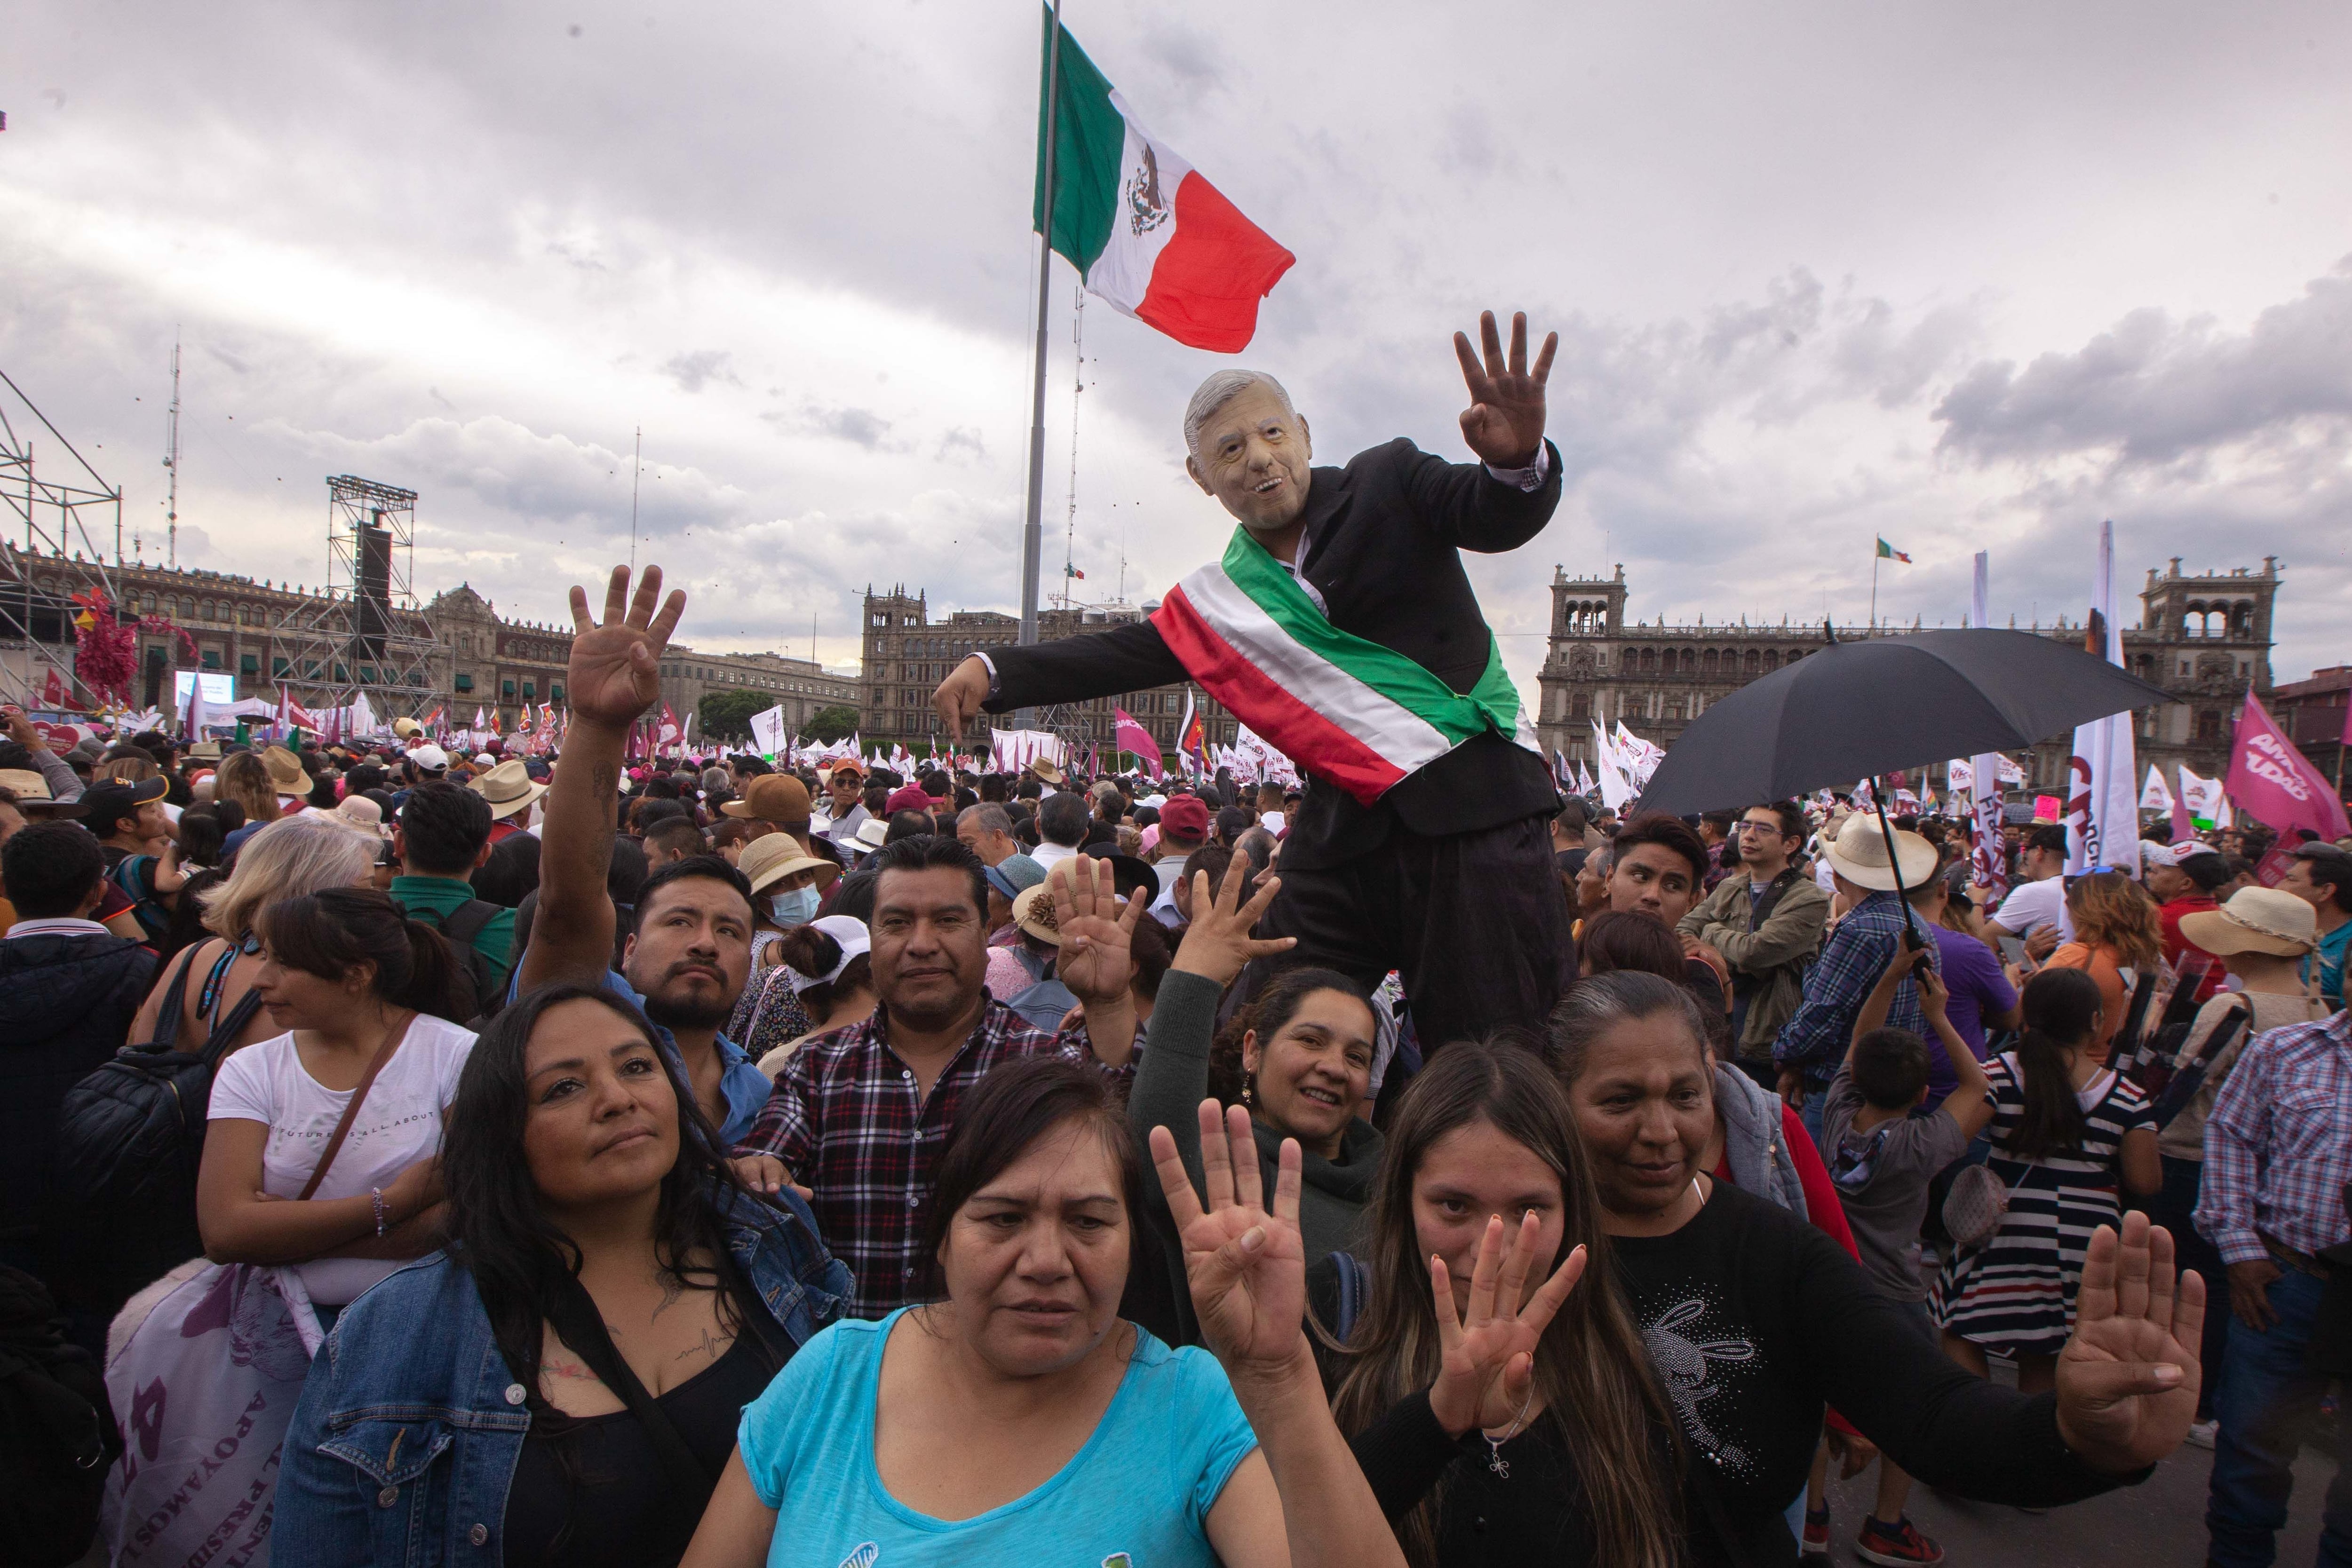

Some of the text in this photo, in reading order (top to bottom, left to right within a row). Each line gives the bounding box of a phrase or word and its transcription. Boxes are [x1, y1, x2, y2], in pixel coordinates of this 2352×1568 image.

[38, 728, 49, 742] 5
[280, 1128, 334, 1138] FUTURE
[362, 1125, 389, 1136] ALL
[395, 1111, 434, 1127] ABOUT
[135, 1390, 267, 1546] APOYAMOS
[183, 1479, 268, 1568] PRESID
